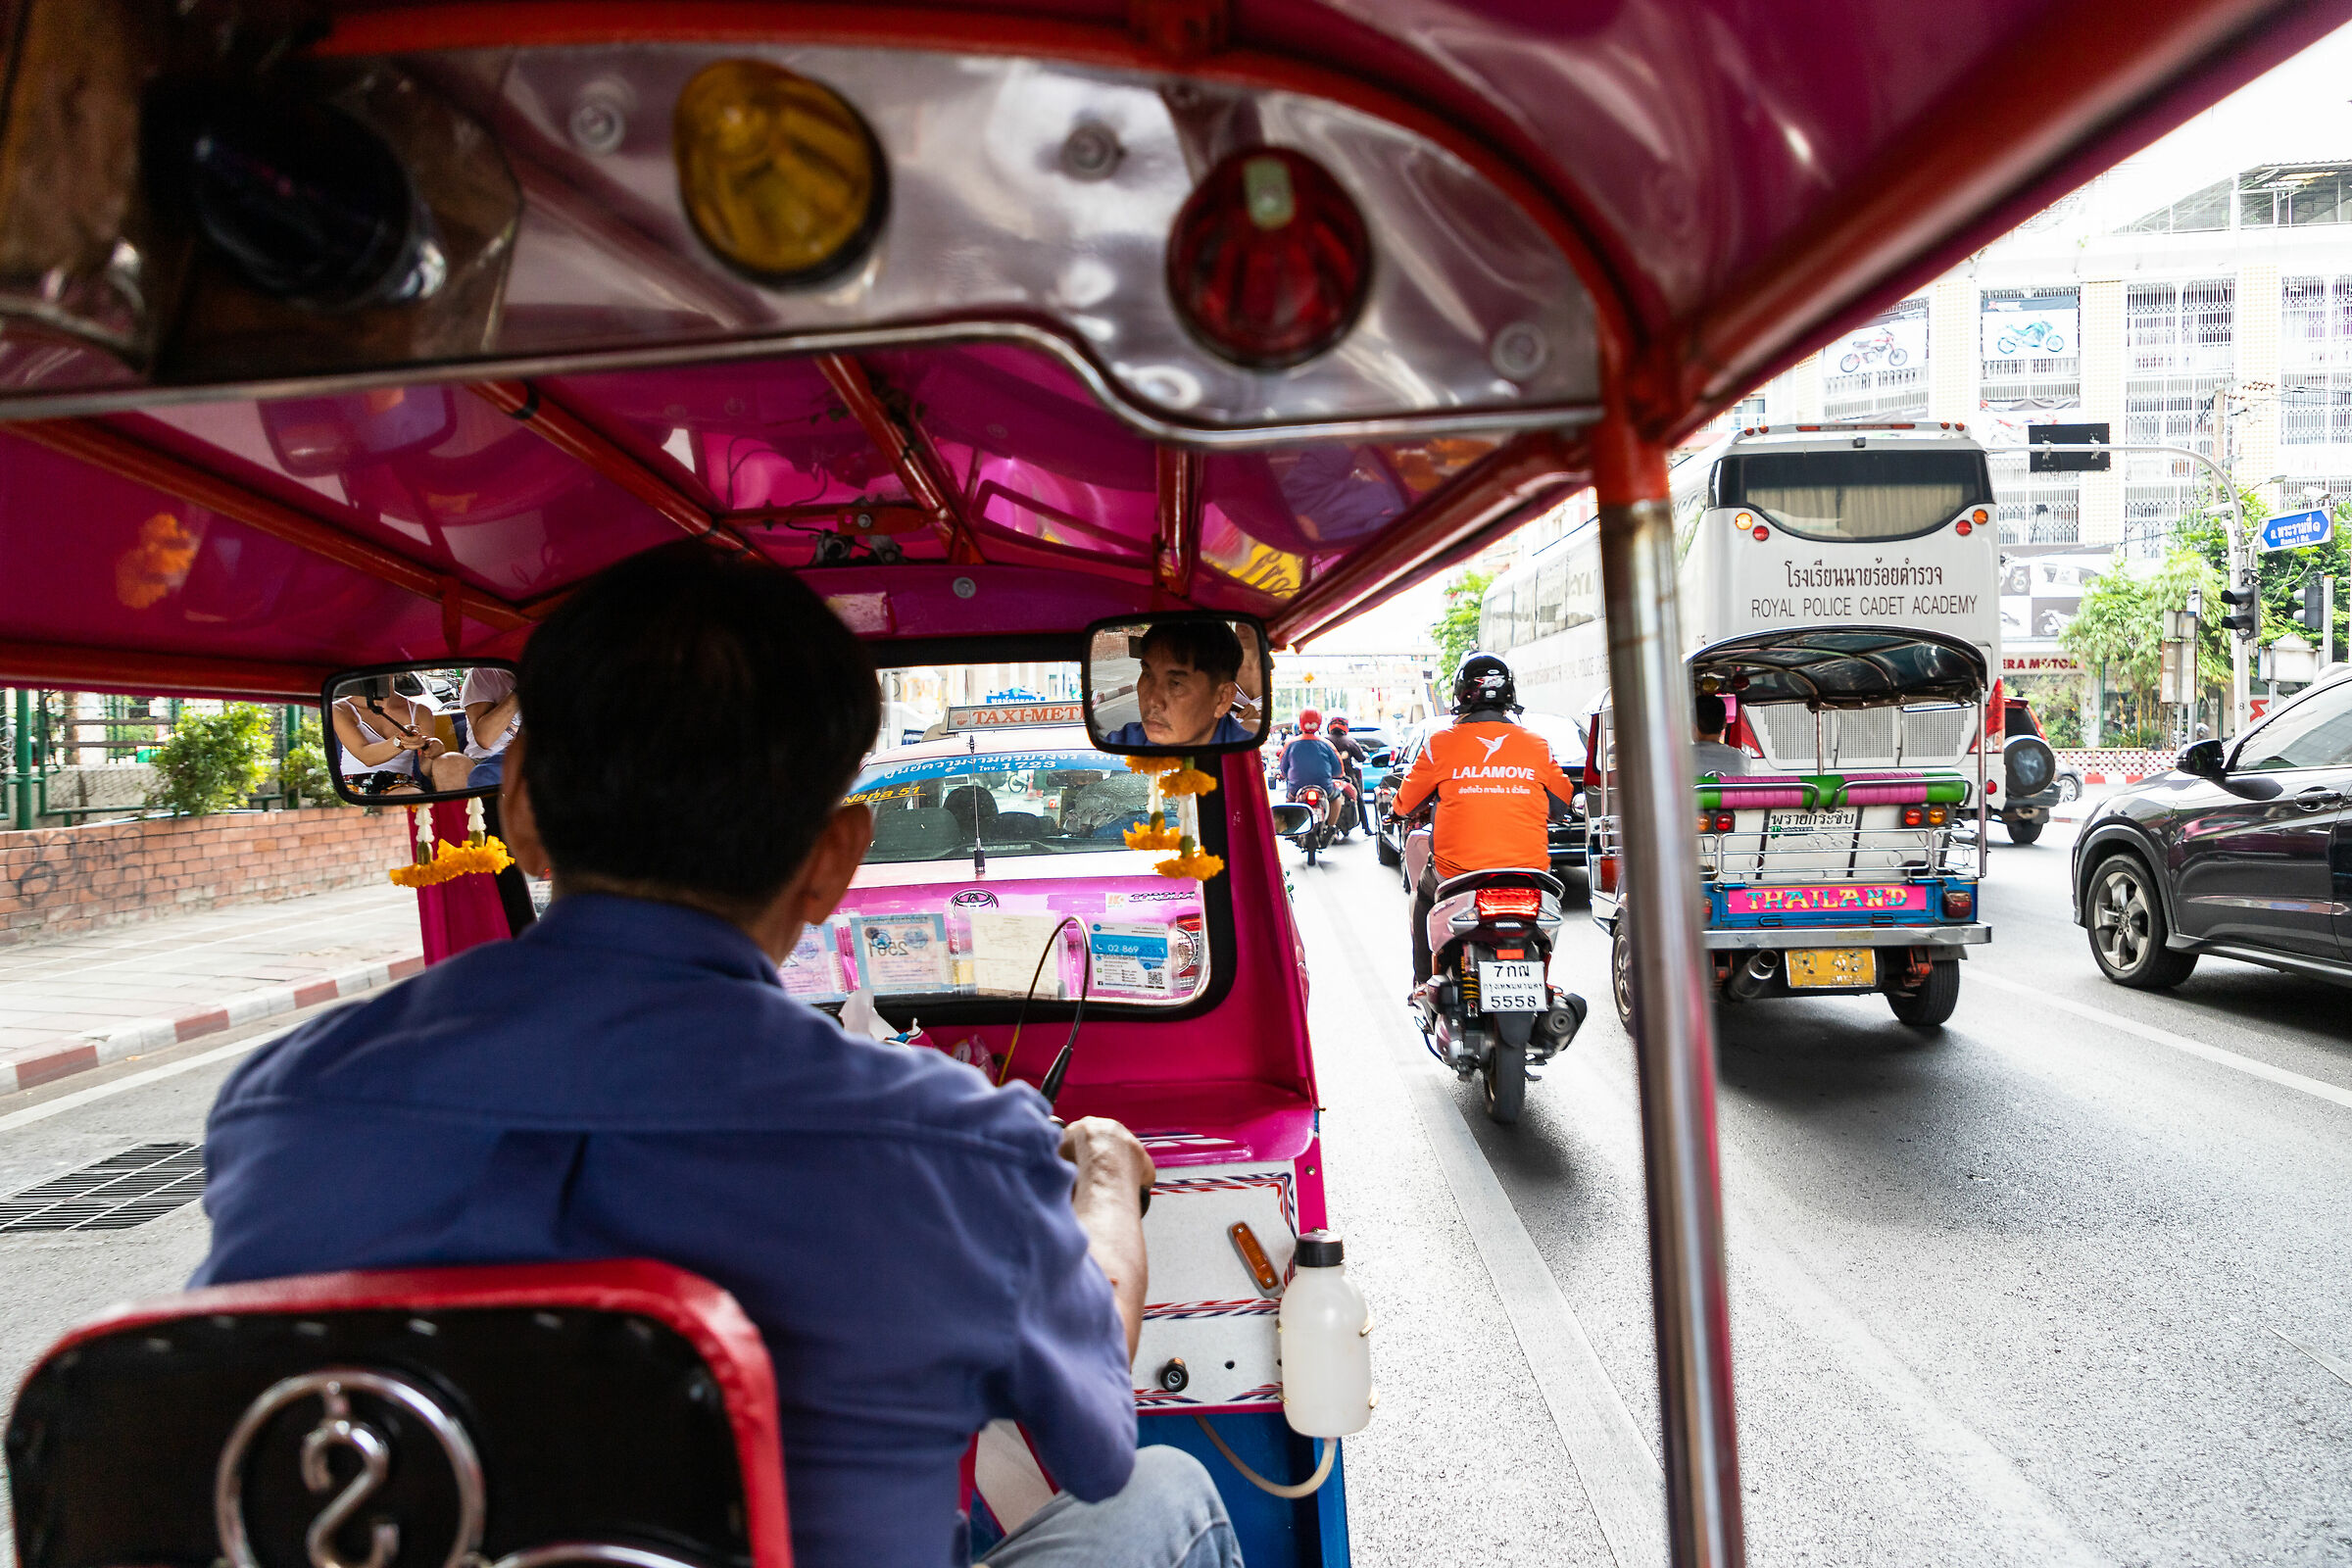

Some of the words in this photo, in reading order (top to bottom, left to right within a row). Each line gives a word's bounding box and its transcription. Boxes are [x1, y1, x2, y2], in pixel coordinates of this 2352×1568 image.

[1785, 557, 1942, 588] โรงเรียนนายร้อยตำรวจ
[1751, 598, 1795, 617] ROYAL
[1803, 597, 1851, 616] POLICE
[1860, 596, 1904, 615] CADET
[1912, 595, 1978, 614] ACADEMY
[1001, 760, 1056, 771] 1723
[1452, 765, 1535, 781] LALAMOVE
[898, 785, 921, 796] 51
[1745, 888, 1908, 910] THAILAND
[1491, 996, 1537, 1007] 5558
